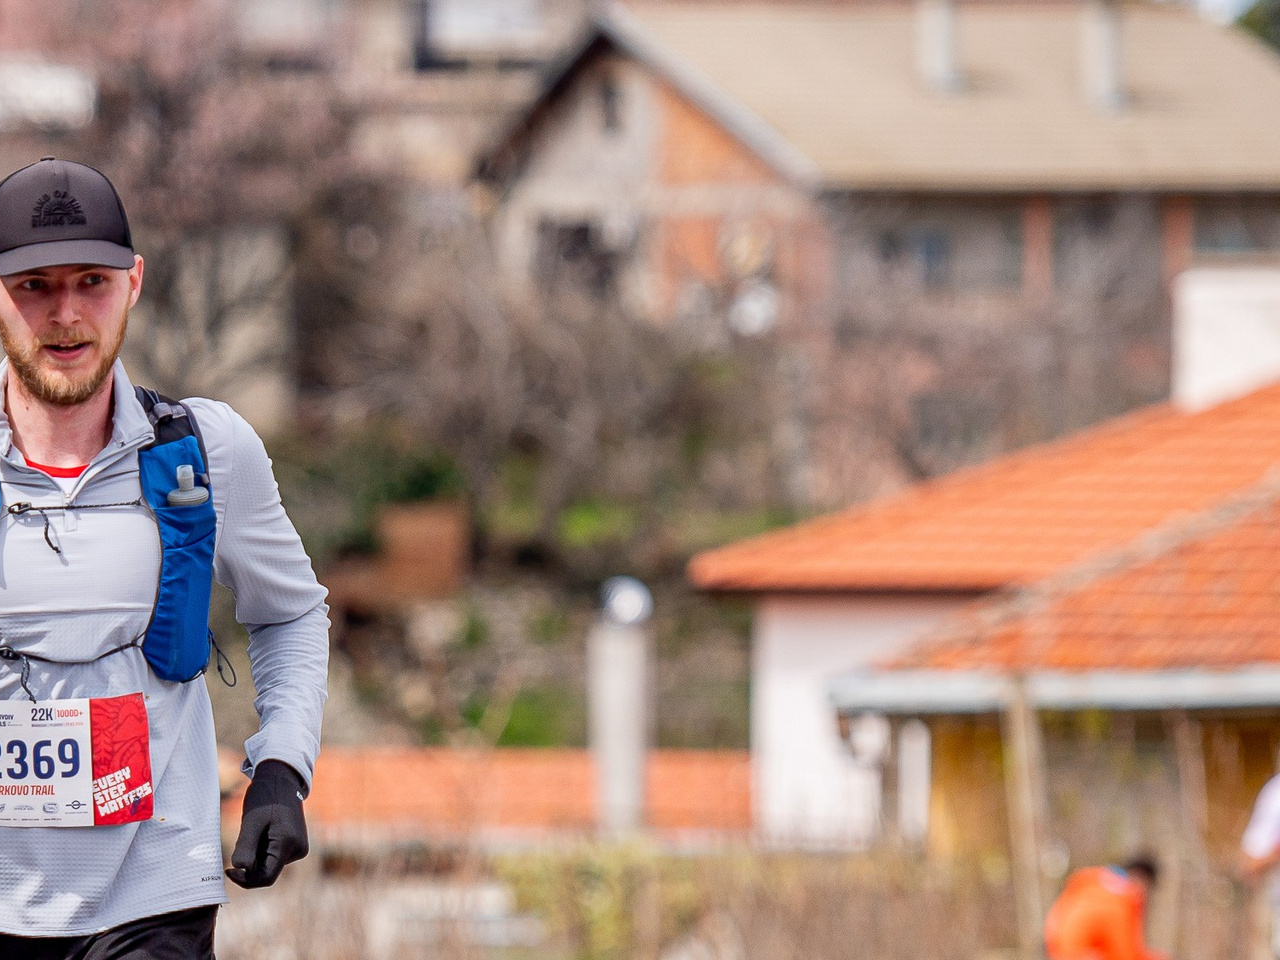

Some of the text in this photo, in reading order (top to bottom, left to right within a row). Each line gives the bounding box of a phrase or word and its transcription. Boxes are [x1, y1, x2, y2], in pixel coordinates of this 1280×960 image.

[30, 707, 53, 722] 22K
[92, 766, 131, 792] EVERY
[30, 784, 56, 796] TRAIL
[93, 782, 127, 805] STEP
